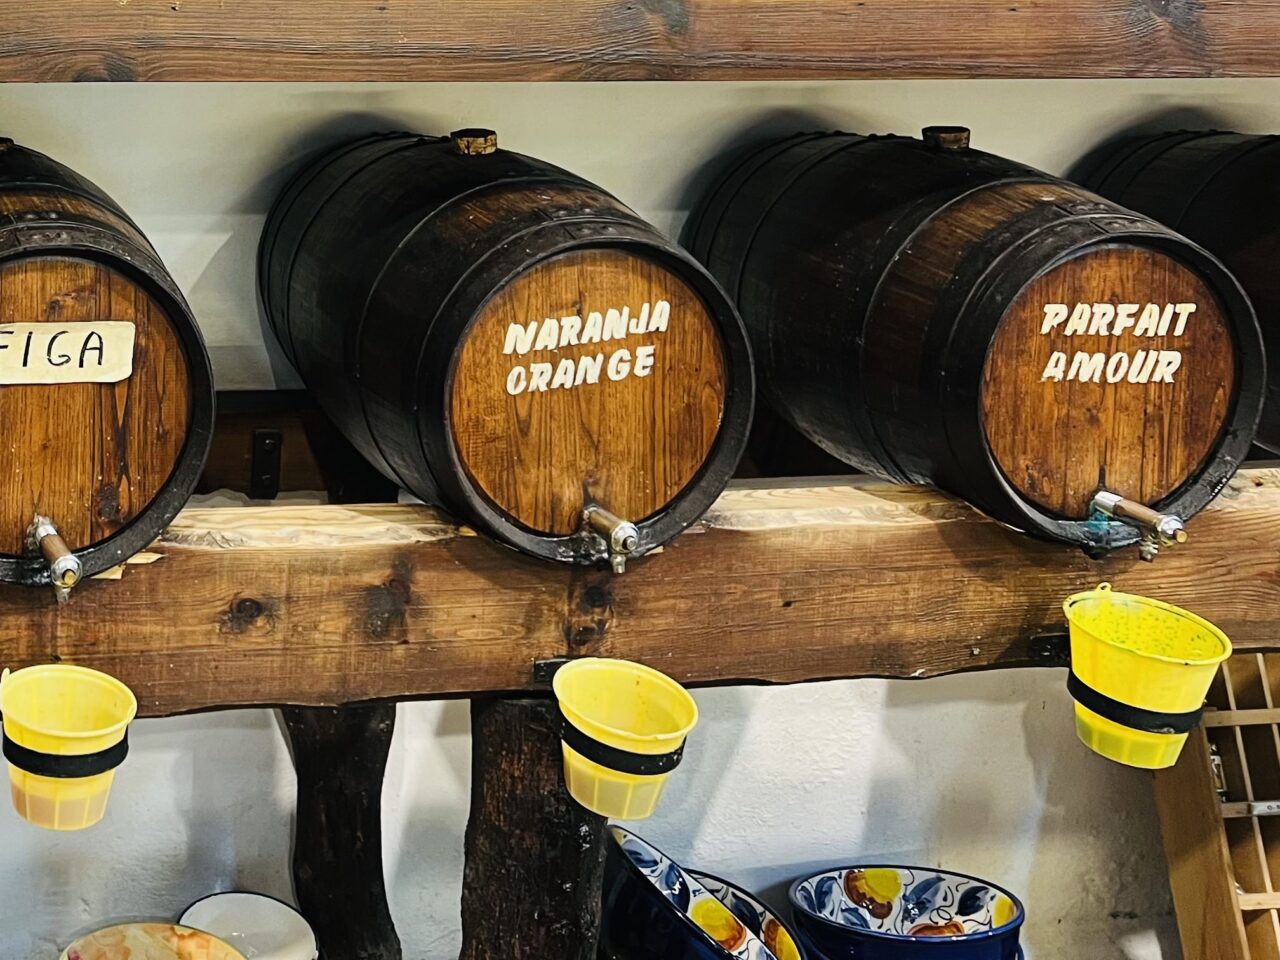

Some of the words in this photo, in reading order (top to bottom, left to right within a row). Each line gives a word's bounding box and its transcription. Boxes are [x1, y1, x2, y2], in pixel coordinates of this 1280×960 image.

[502, 300, 671, 355] NARANJA
[1040, 302, 1197, 337] PARFAIT
[506, 344, 656, 396] ORANGE
[1039, 349, 1182, 384] AMOUR
